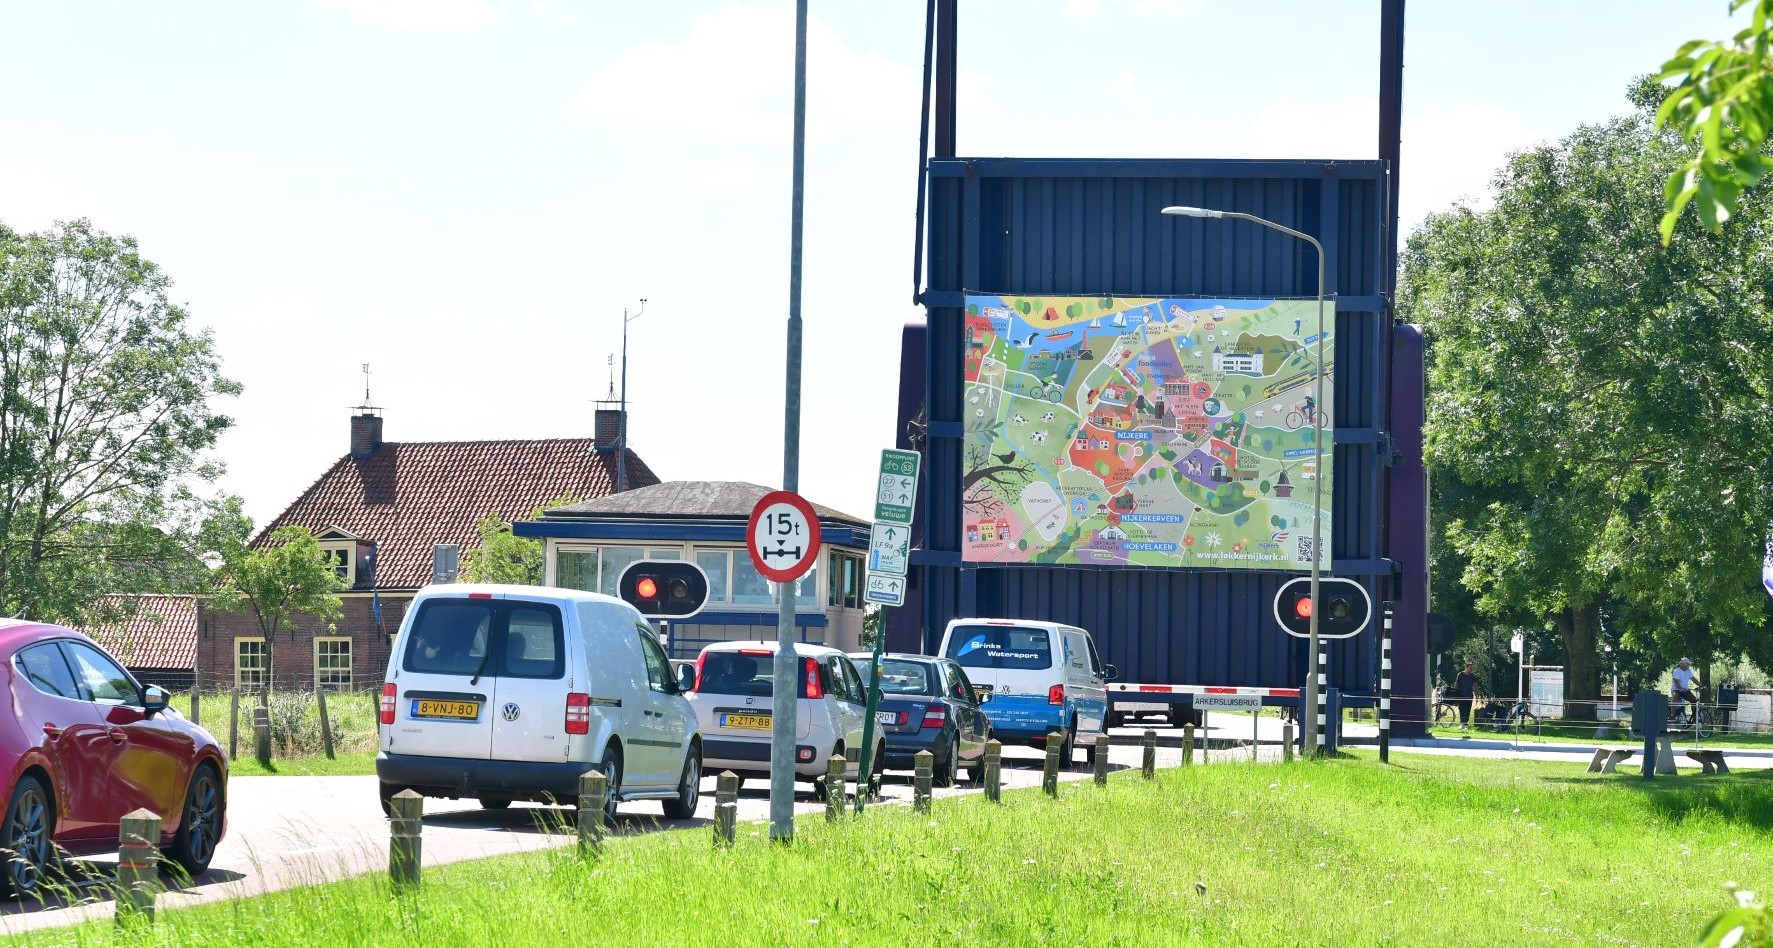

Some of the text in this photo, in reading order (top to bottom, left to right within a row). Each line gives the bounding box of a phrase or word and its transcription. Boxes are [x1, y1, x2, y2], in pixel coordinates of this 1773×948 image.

[1117, 432, 1149, 440] NIJKERK
[885, 453, 916, 461] KNOOPPUNT
[903, 464, 912, 472] 52
[1121, 514, 1180, 522] NIJKERKERVEEN
[1124, 542, 1173, 551] HOEVELAKEN
[971, 641, 1001, 649] Brinks
[987, 650, 1039, 659] Watersport
[1195, 698, 1259, 707] ARKERSLUISBRUG
[421, 702, 473, 715] 8-VNJ-80
[729, 716, 770, 727] 9-ZTP-88
